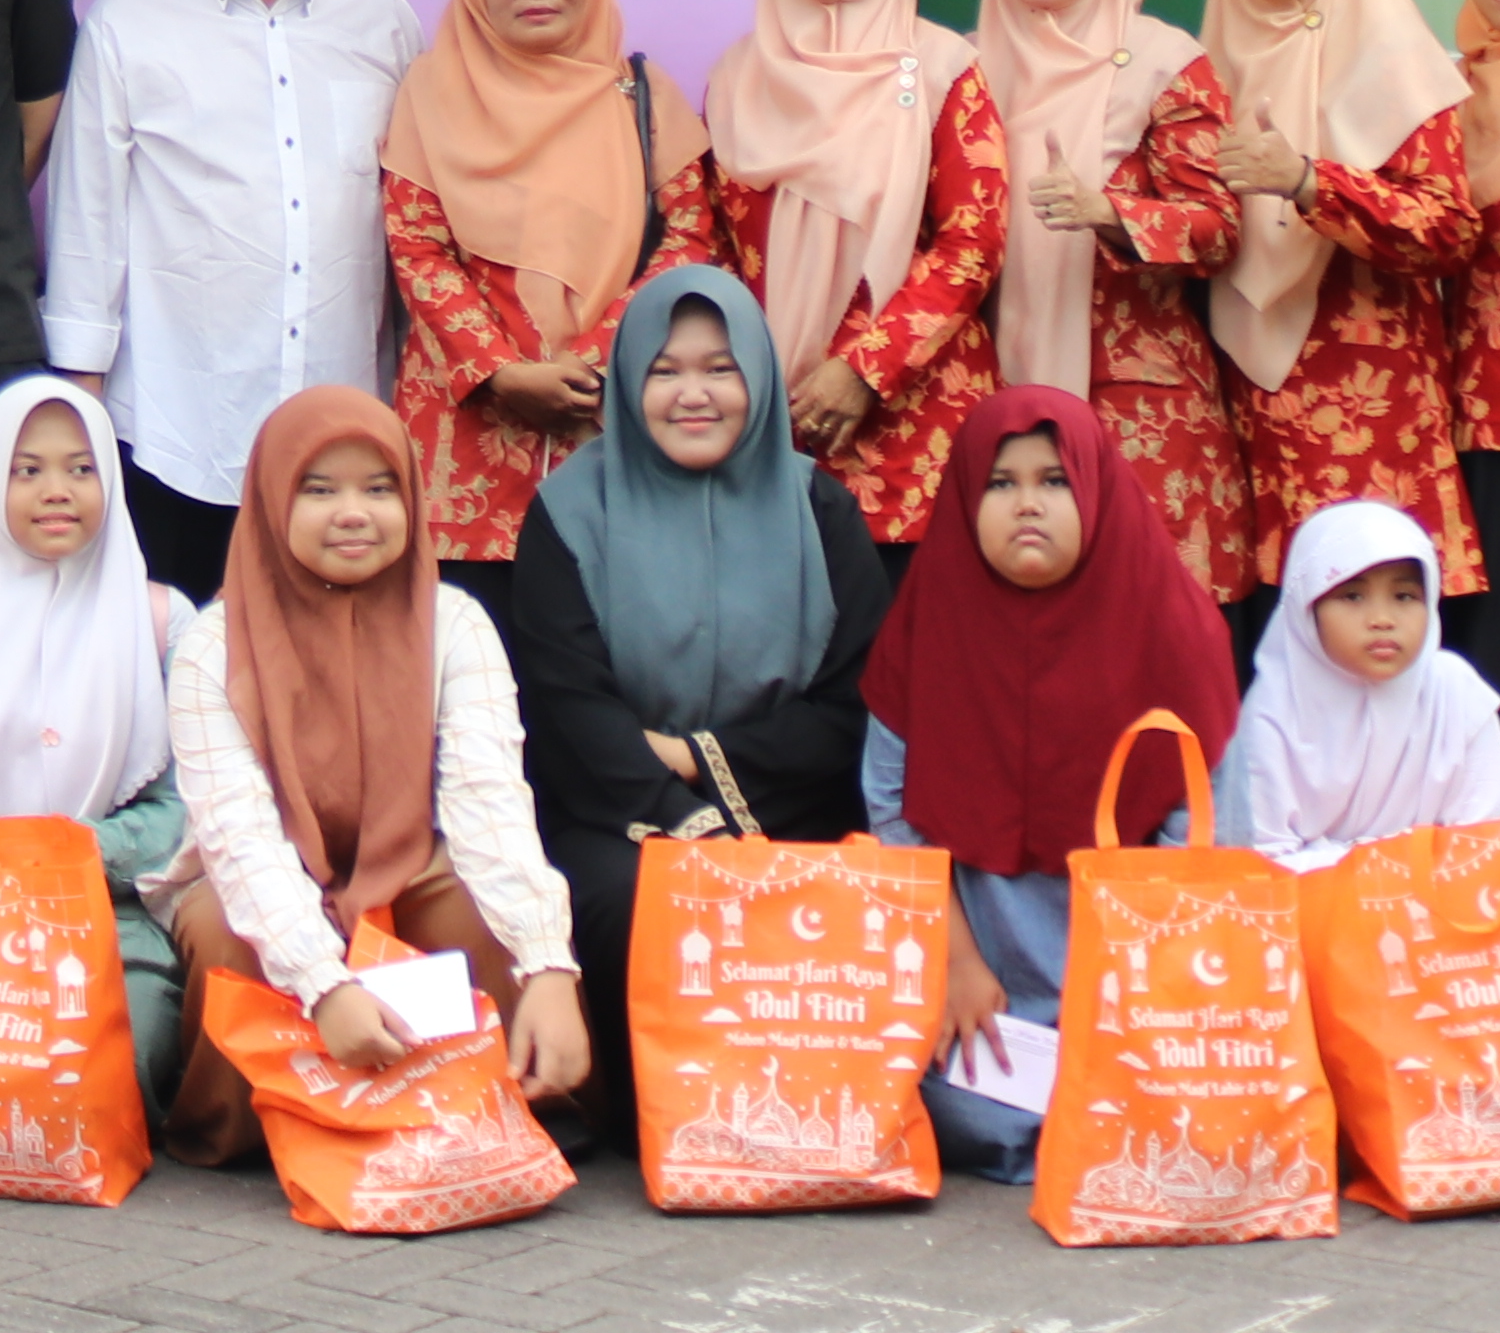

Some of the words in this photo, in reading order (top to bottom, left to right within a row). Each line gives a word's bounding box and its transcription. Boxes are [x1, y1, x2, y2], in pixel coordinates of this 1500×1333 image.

[720, 960, 791, 983] Selamat
[792, 959, 838, 986] Hari
[840, 963, 888, 990] Raya
[1417, 951, 1490, 978] Selamat
[743, 990, 800, 1020] Idul
[805, 993, 866, 1023] Fitri
[1128, 1006, 1195, 1030] Selamat
[1196, 1004, 1243, 1032] Hari
[1152, 1036, 1206, 1068] Idul
[1210, 1038, 1274, 1068] Fitri
